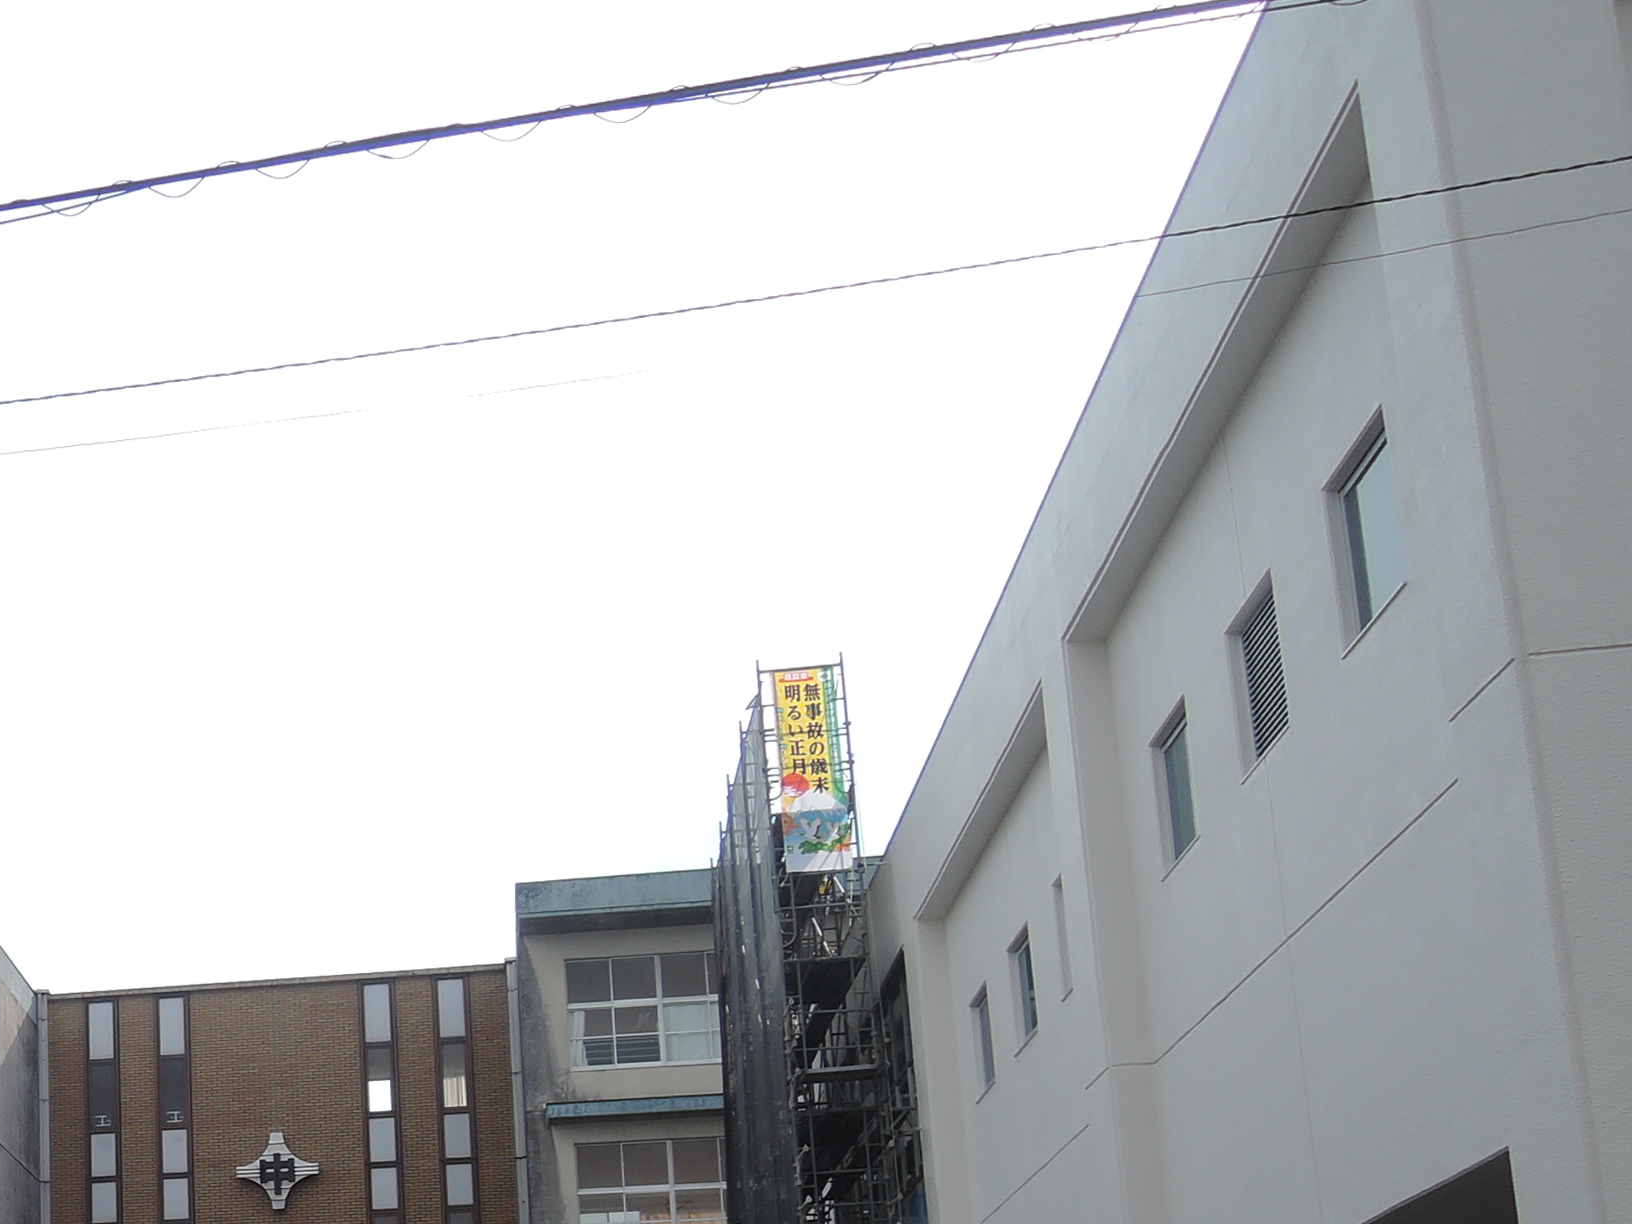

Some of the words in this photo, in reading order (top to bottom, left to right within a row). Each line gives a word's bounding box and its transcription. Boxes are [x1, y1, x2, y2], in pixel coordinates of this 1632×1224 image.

[784, 684, 806, 775] 明るい正月
[803, 683, 829, 793] 無事故の歳末
